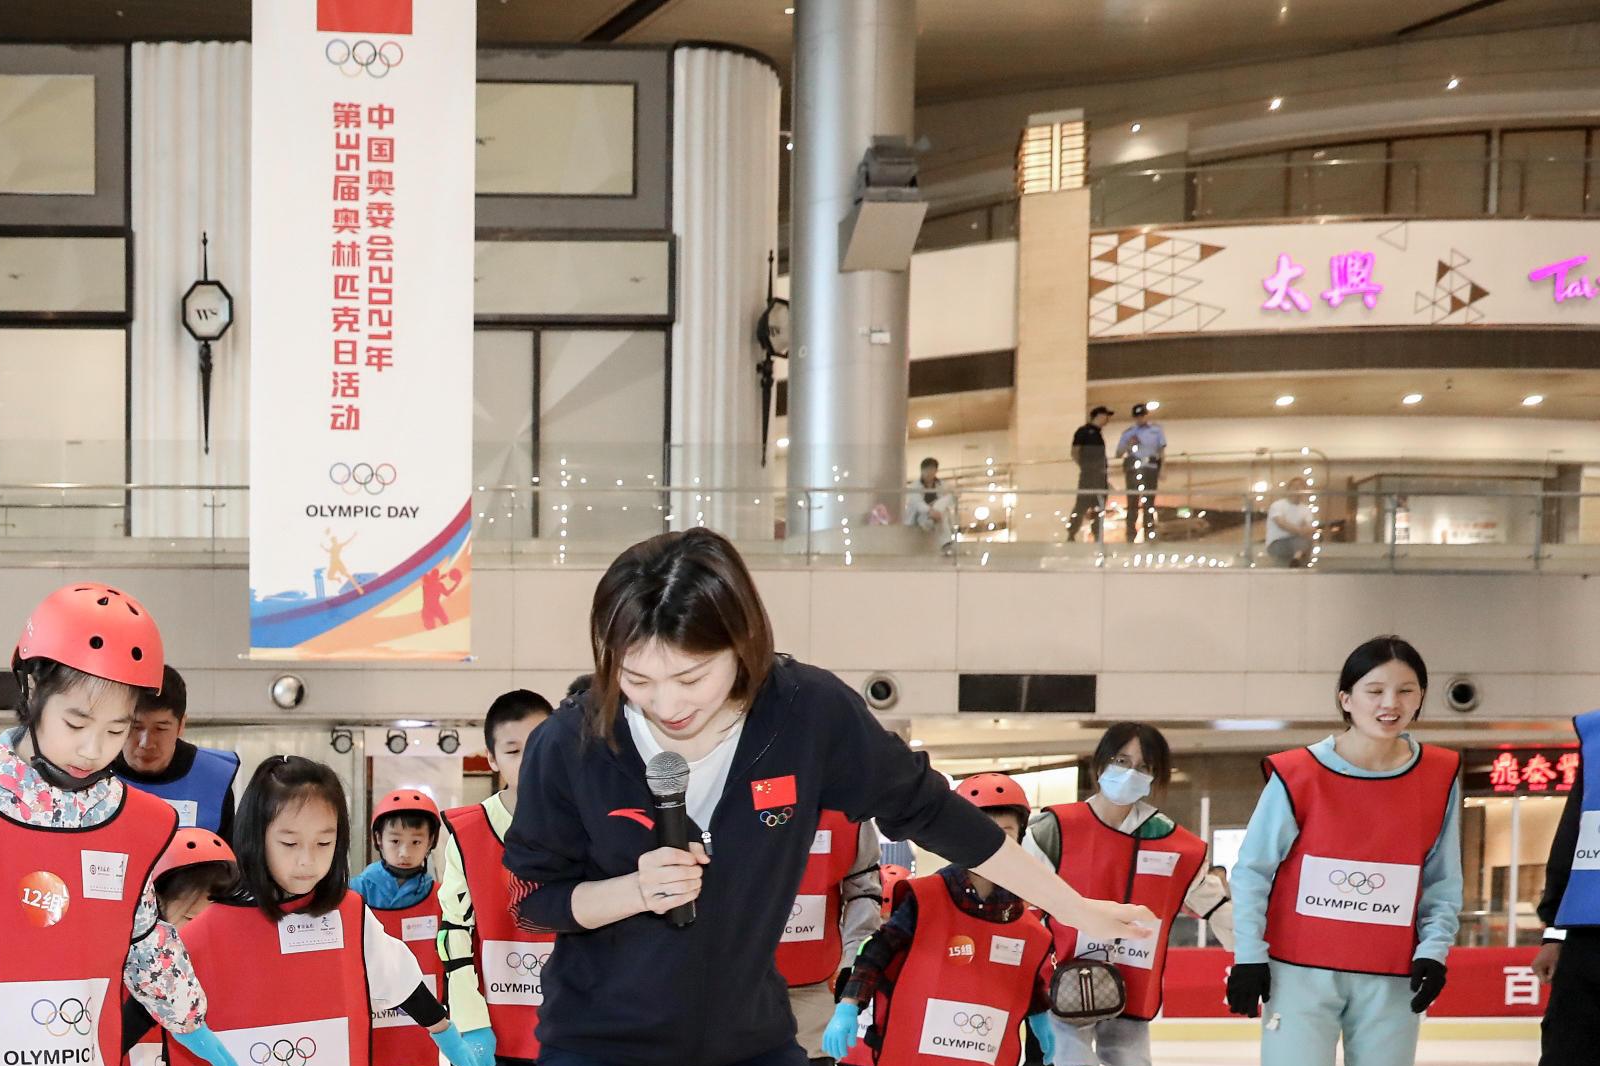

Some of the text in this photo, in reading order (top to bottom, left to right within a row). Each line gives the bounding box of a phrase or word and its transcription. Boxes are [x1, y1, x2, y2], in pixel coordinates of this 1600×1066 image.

[365, 104, 395, 372] 中国奥委会2021年
[330, 102, 361, 430] 第35届奥林匹克日活动
[306, 504, 419, 518] OLYMPIC DAY
[1305, 895, 1400, 914] OLYMPIC DAY
[795, 925, 815, 933] DAY
[1128, 948, 1150, 959] DAY
[932, 1037, 986, 1051] OLYMPIC
[4, 1048, 90, 1066] OLYMPIC
